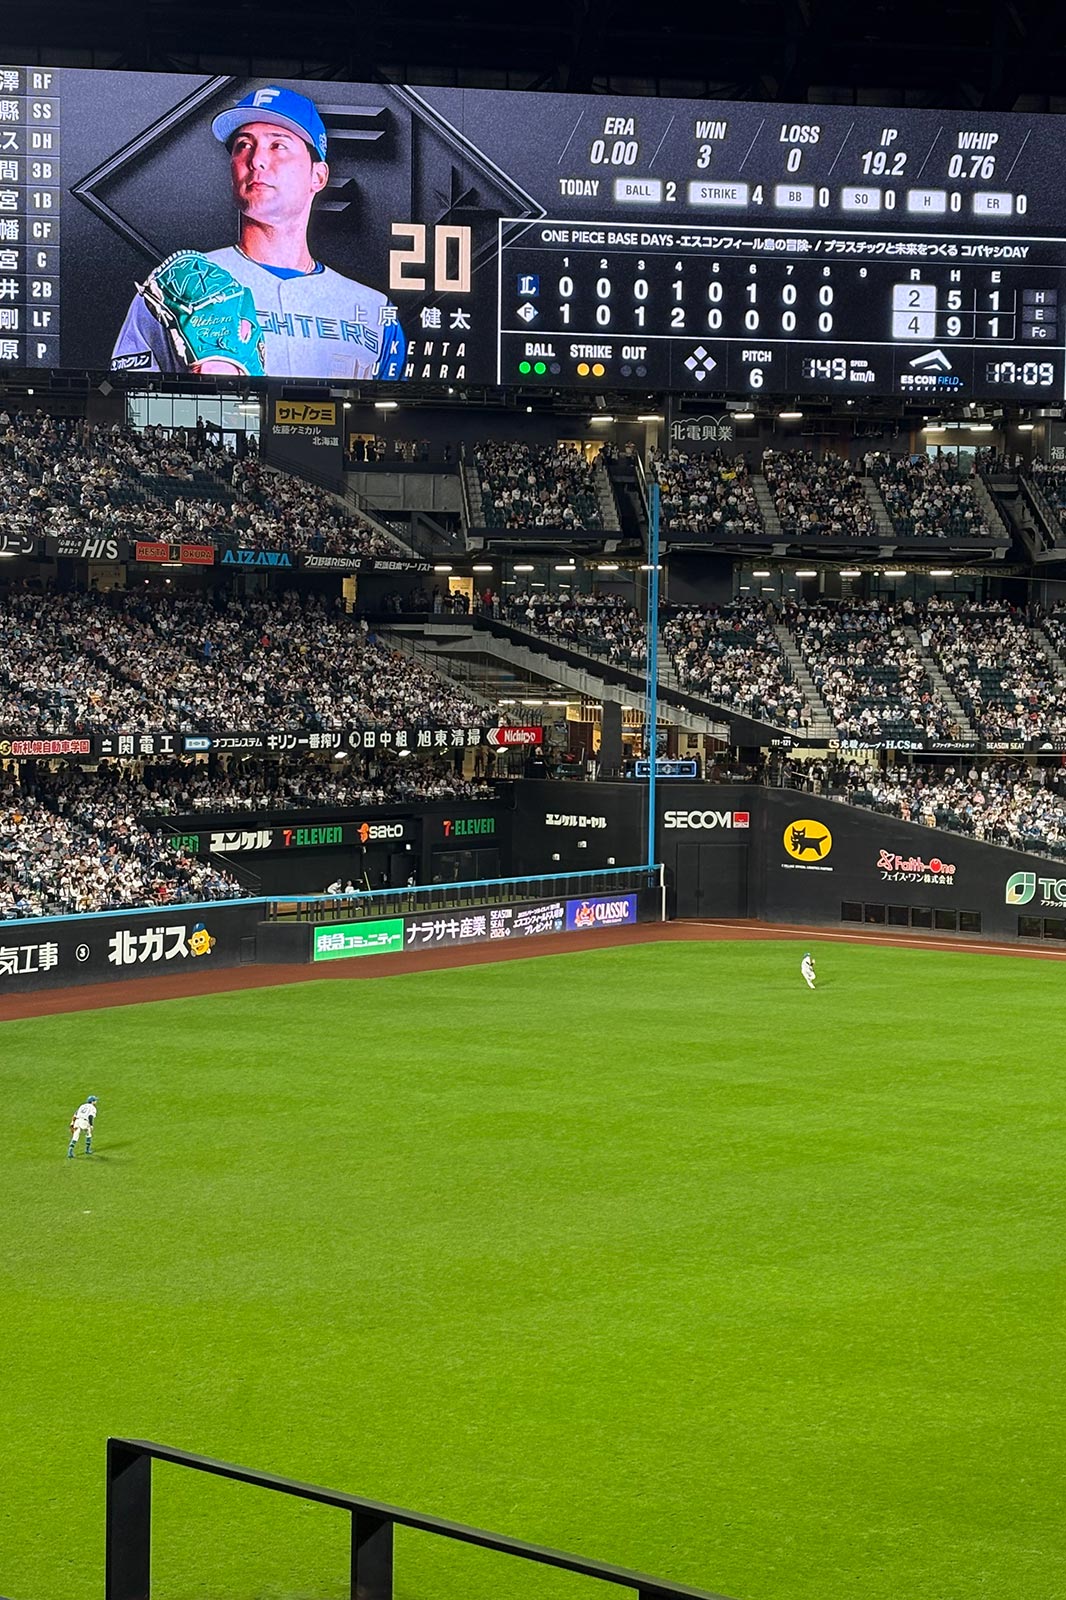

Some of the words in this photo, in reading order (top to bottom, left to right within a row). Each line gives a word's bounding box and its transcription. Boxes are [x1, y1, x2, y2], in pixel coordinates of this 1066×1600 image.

[33, 73, 52, 89] RF
[33, 103, 52, 119] SS
[0, 131, 19, 150] ス
[32, 132, 52, 148] DH
[604, 118, 634, 135] ERA
[696, 121, 727, 139] WIN
[780, 125, 820, 143] LOSS
[880, 129, 898, 146] IP
[958, 132, 998, 150] WHIP
[590, 140, 638, 165] 0.00
[697, 144, 712, 168] 3
[787, 148, 802, 172] 0
[862, 151, 907, 176] 19.2
[948, 154, 996, 179] 0.76
[0, 160, 18, 180] 間
[32, 162, 52, 178] 3B
[0, 190, 18, 210] 宮
[33, 192, 52, 208] 1B
[560, 179, 599, 196] TODAY
[626, 185, 650, 196] BALL
[666, 181, 676, 201] 2
[701, 188, 736, 200] STRIKE
[752, 185, 763, 204] 4
[789, 192, 802, 202] BB
[819, 188, 830, 208] 0
[855, 194, 868, 204] SO
[885, 190, 896, 210] 0
[924, 196, 931, 206] H
[951, 192, 962, 212] 0
[987, 198, 1000, 209] ER
[1016, 194, 1026, 214] 0
[0, 219, 19, 240] 幡
[33, 222, 52, 238] CF
[542, 230, 569, 242] ONE
[572, 230, 604, 244] PIECE
[608, 232, 638, 245] BASE
[641, 233, 674, 246] DAYS
[824, 240, 958, 256] プラスチックと未来をつくる
[961, 244, 1028, 258] コバヤシDAY
[0, 249, 18, 269] 宮
[37, 252, 47, 268] C
[389, 223, 471, 292] 20
[563, 258, 569, 268] 1
[600, 258, 608, 269] 2
[638, 260, 645, 270] 3
[675, 261, 682, 271] 4
[712, 263, 720, 272] 5
[750, 264, 756, 274] 6
[786, 266, 794, 275] 7
[823, 266, 830, 276] 8
[860, 268, 867, 278] 9
[910, 270, 920, 280] R
[951, 271, 960, 282] H
[991, 272, 1000, 282] E
[0, 279, 19, 299] 井
[32, 281, 52, 298] 2B
[559, 276, 574, 297] 0
[596, 278, 611, 298] 0
[634, 279, 648, 300] 0
[672, 280, 682, 300] 1
[708, 282, 722, 302] 0
[746, 283, 756, 303] 1
[782, 284, 797, 304] 0
[819, 285, 834, 306] 0
[909, 290, 920, 307] 2
[948, 290, 962, 310] 5
[989, 291, 999, 310] 1
[1035, 293, 1044, 303] H
[0, 308, 18, 330] 剛
[33, 311, 51, 327] LF
[348, 305, 398, 327] 上原
[420, 306, 471, 329] 健太
[560, 304, 570, 324] 1
[596, 304, 610, 326] 0
[635, 306, 645, 326] 1
[671, 308, 685, 328] 2
[708, 308, 722, 329] 0
[745, 310, 759, 330] 0
[782, 311, 796, 332] 0
[818, 312, 833, 333] 0
[908, 317, 920, 334] 4
[947, 316, 961, 336] 9
[988, 317, 998, 337] 1
[1035, 310, 1044, 320] E
[1032, 327, 1046, 338] Fc
[0, 339, 19, 360] 原
[37, 343, 47, 359] P
[390, 340, 466, 357] KENTA
[525, 343, 556, 357] BALL
[570, 344, 612, 359] STRIKE
[622, 346, 647, 360] OUT
[742, 350, 772, 362] PITCH
[372, 362, 466, 379] UEHARA
[750, 368, 763, 388] 6
[810, 358, 847, 381] 149
[850, 370, 875, 383] km/h
[994, 362, 1054, 386] 17:09
[272, 425, 321, 436] 佐藤ケミカル
[670, 424, 732, 441] 北電興業
[312, 436, 339, 446] 北海道
[1051, 446, 1066, 460] 福
[81, 539, 118, 560] HIS
[138, 547, 166, 556] HESTA
[183, 550, 212, 558] OKURA
[221, 550, 292, 567] AIZAWA
[12, 739, 90, 756] 新札幌自動車学園
[267, 734, 341, 750] キリン一番搾り
[364, 730, 408, 748] 田中組
[417, 729, 481, 748] 旭東清掃
[986, 742, 1009, 750] SEASON
[1010, 742, 1025, 750] SEAT
[546, 814, 578, 827] ユンケル
[579, 815, 608, 829] ローヤル
[664, 810, 731, 829] SECOM
[210, 830, 273, 852] ユンケル
[894, 856, 956, 874] Faith-One
[880, 871, 954, 886] フェイス・ワン株式会社
[490, 908, 512, 920] SEASON
[595, 901, 629, 920] CLASSIC
[406, 915, 486, 944] ナラサキ産業
[490, 918, 504, 928] SEAT
[108, 926, 189, 966] 北ガス
[318, 933, 400, 952] 東急コミュニティー
